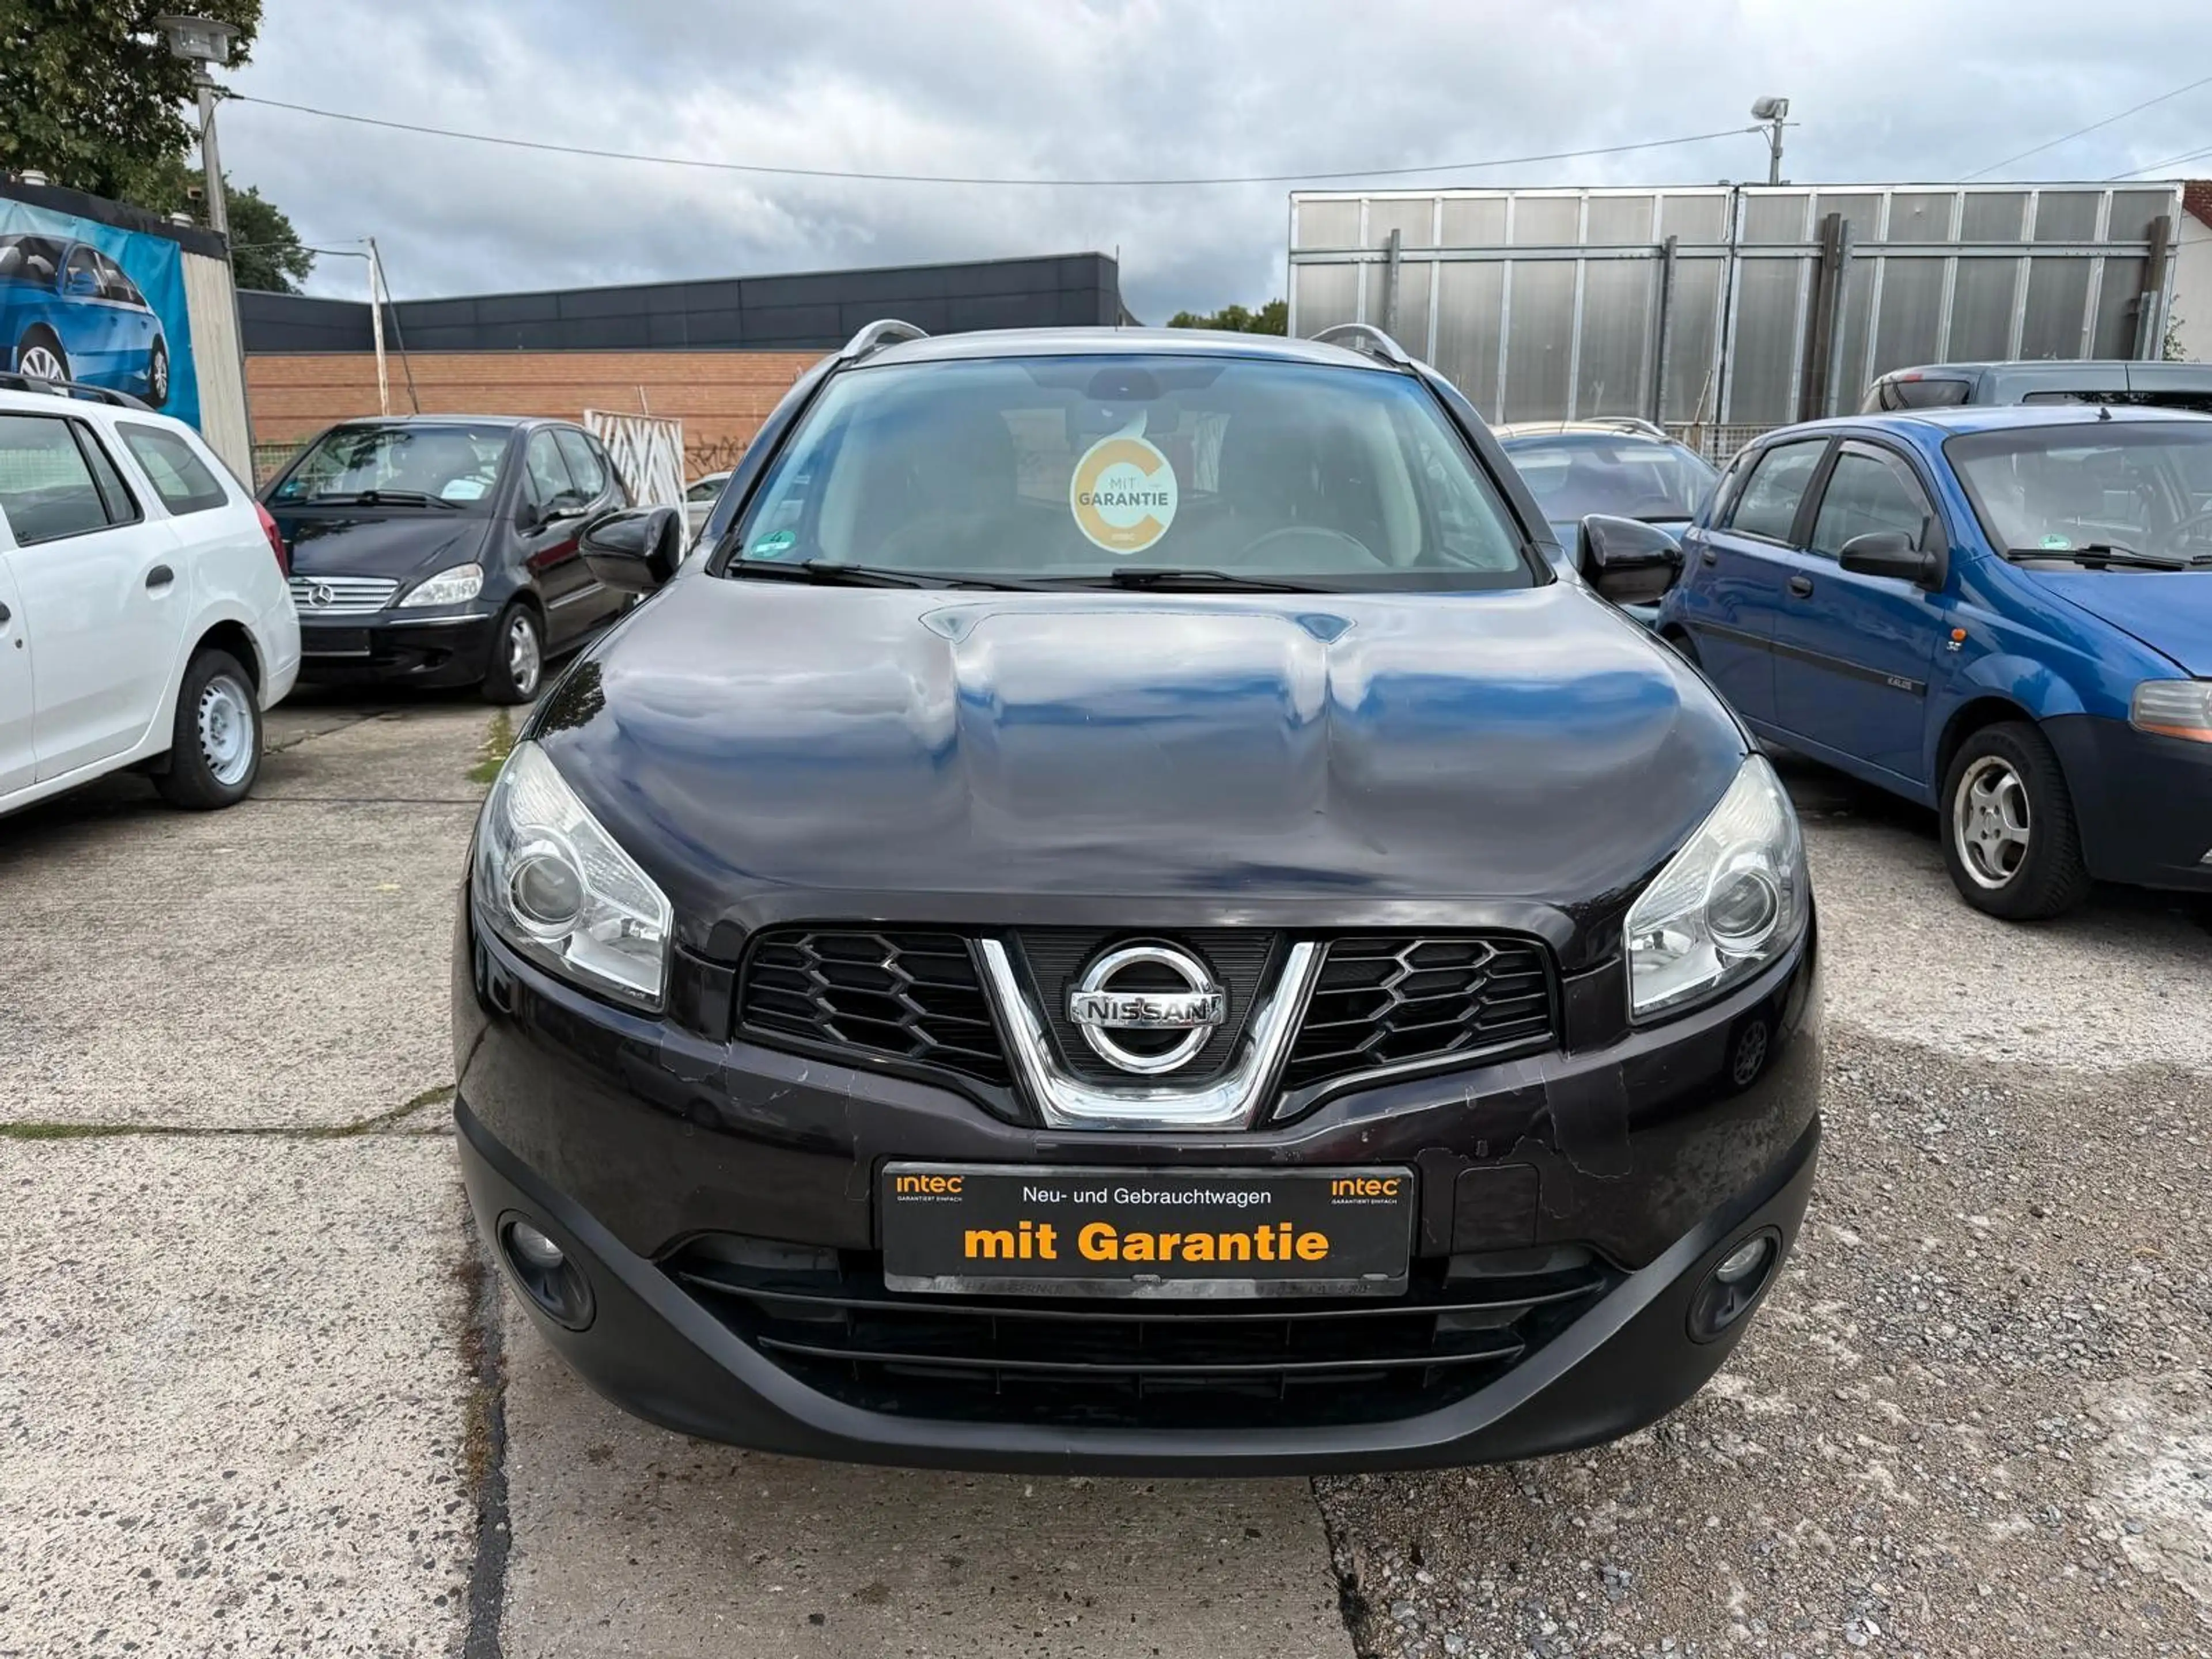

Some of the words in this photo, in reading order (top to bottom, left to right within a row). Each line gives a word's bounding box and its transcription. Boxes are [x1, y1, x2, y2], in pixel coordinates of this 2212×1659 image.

[1109, 478, 1137, 489] MIT
[1078, 492, 1169, 506] GARANTIE
[1088, 1000, 1207, 1021] NISSAN
[896, 1175, 963, 1193] intec
[1332, 1177, 1398, 1196] intec
[1022, 1187, 1067, 1203] Neu-
[1074, 1188, 1107, 1203] und
[1114, 1187, 1272, 1208] Gebrauchtwagen
[964, 1220, 1057, 1259] mit
[1078, 1222, 1329, 1262] Garantie
